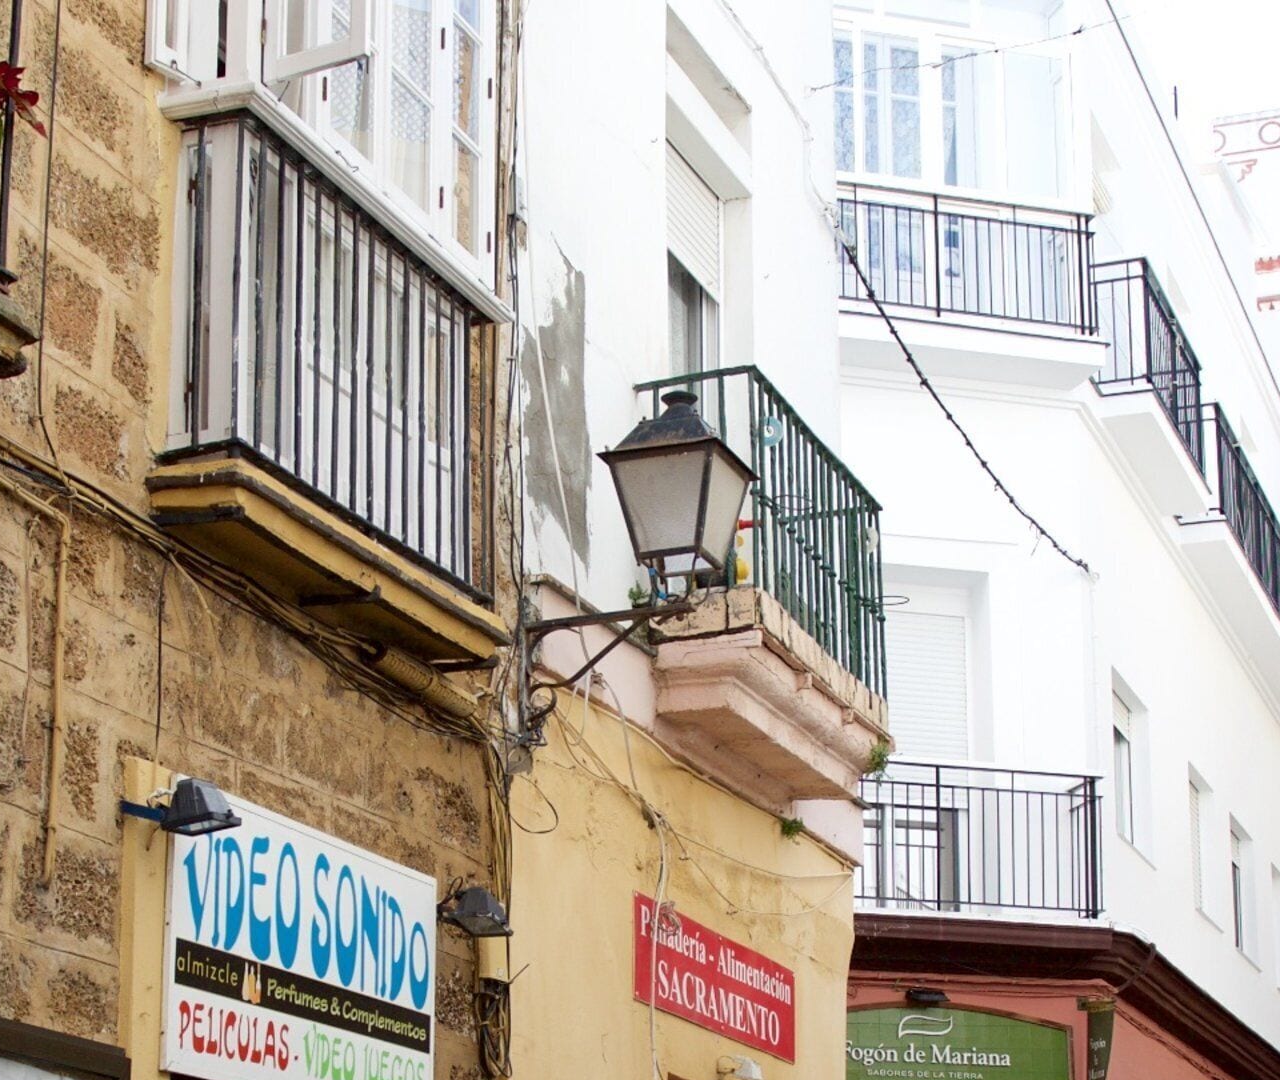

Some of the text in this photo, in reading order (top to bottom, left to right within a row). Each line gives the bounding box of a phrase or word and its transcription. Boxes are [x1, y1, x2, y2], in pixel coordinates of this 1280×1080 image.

[183, 832, 429, 1010] VIDEO SONIDO
[176, 954, 239, 988] almizcle
[717, 946, 791, 1006] Alimentación
[267, 978, 427, 1041] Perfumes & Complementos
[657, 960, 780, 1046] SACRAMENTO
[179, 1000, 290, 1071] PELICULAS
[903, 1043, 926, 1063] de
[930, 1044, 1011, 1067] Mariana
[867, 1068, 984, 1080] SABORES DE LA TIERRA
